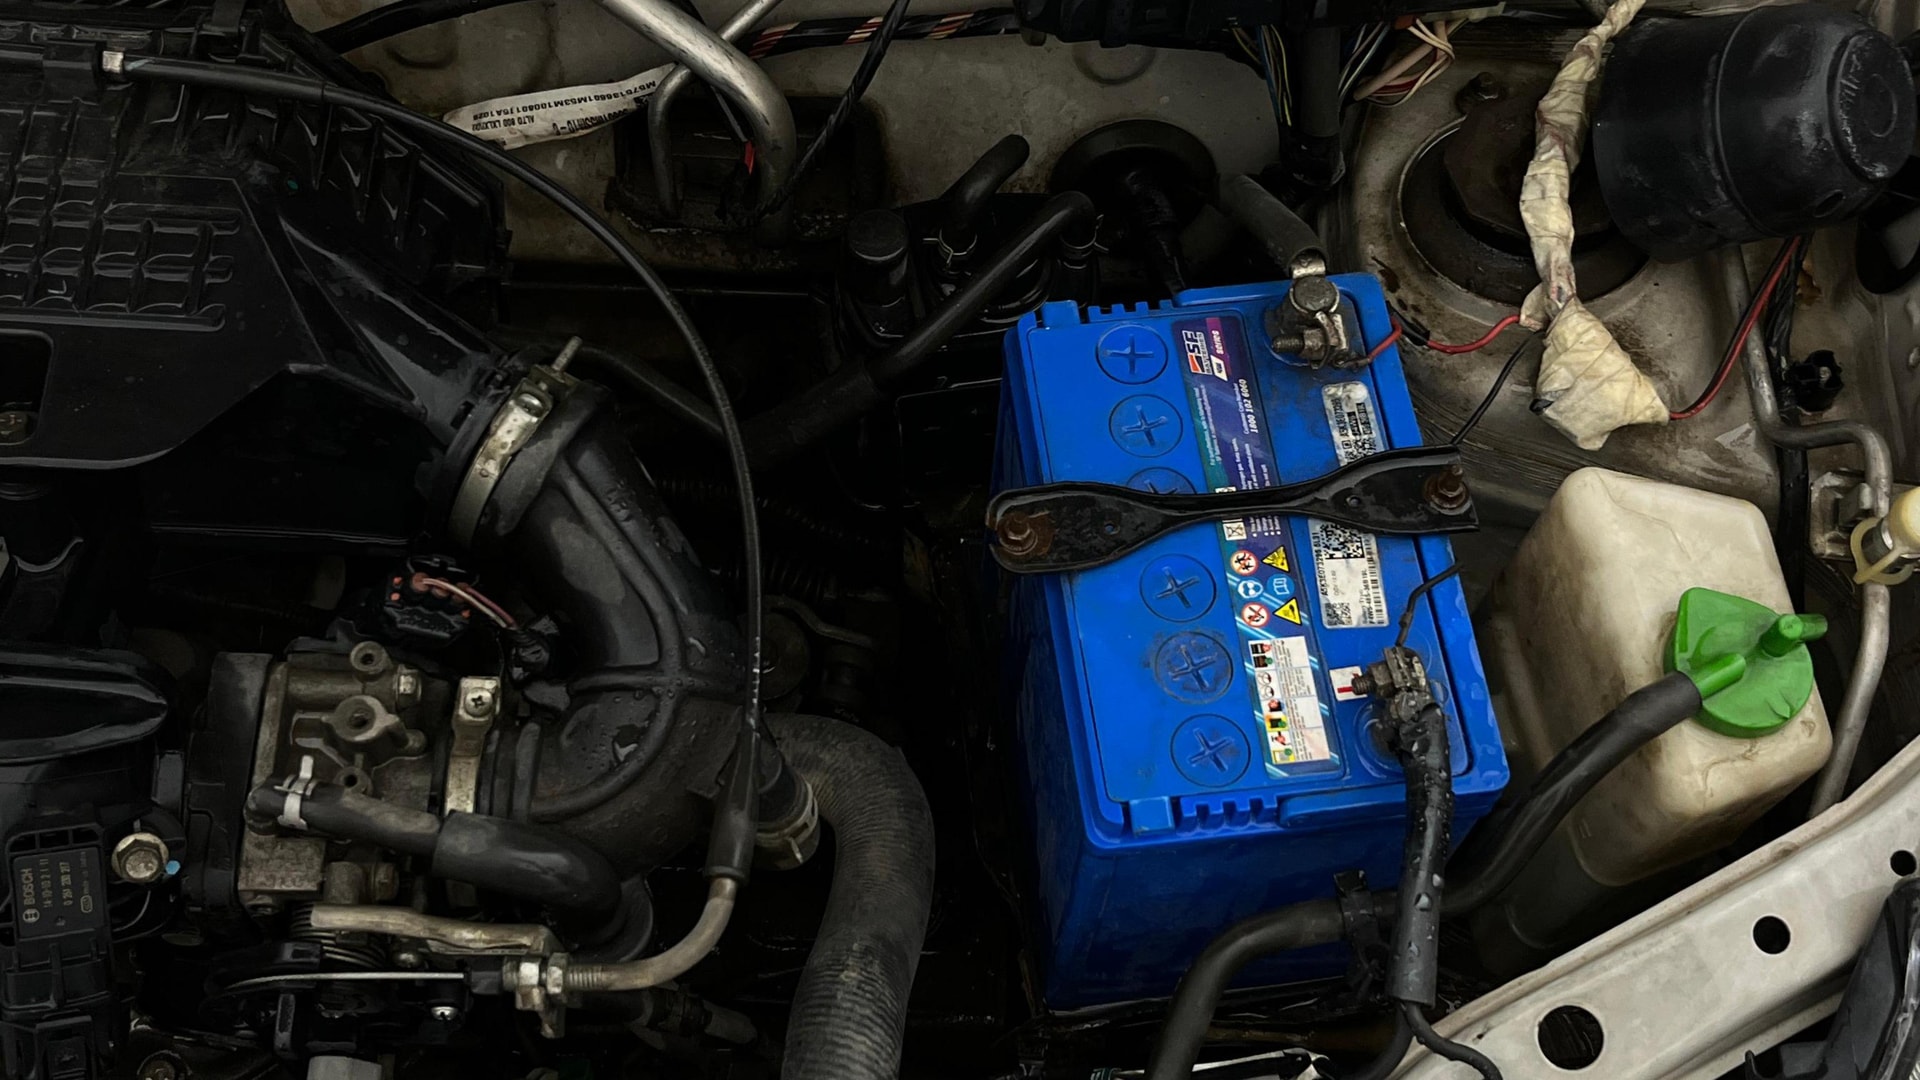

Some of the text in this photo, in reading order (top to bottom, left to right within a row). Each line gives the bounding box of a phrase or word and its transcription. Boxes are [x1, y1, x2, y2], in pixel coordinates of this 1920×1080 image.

[503, 117, 515, 127] 800
[519, 115, 535, 126] ALTO
[1184, 331, 1200, 354] SF
[1211, 329, 1223, 354] series
[1243, 398, 1253, 413] 102
[1246, 413, 1258, 434] 1800
[21, 868, 35, 905] BOSCH
